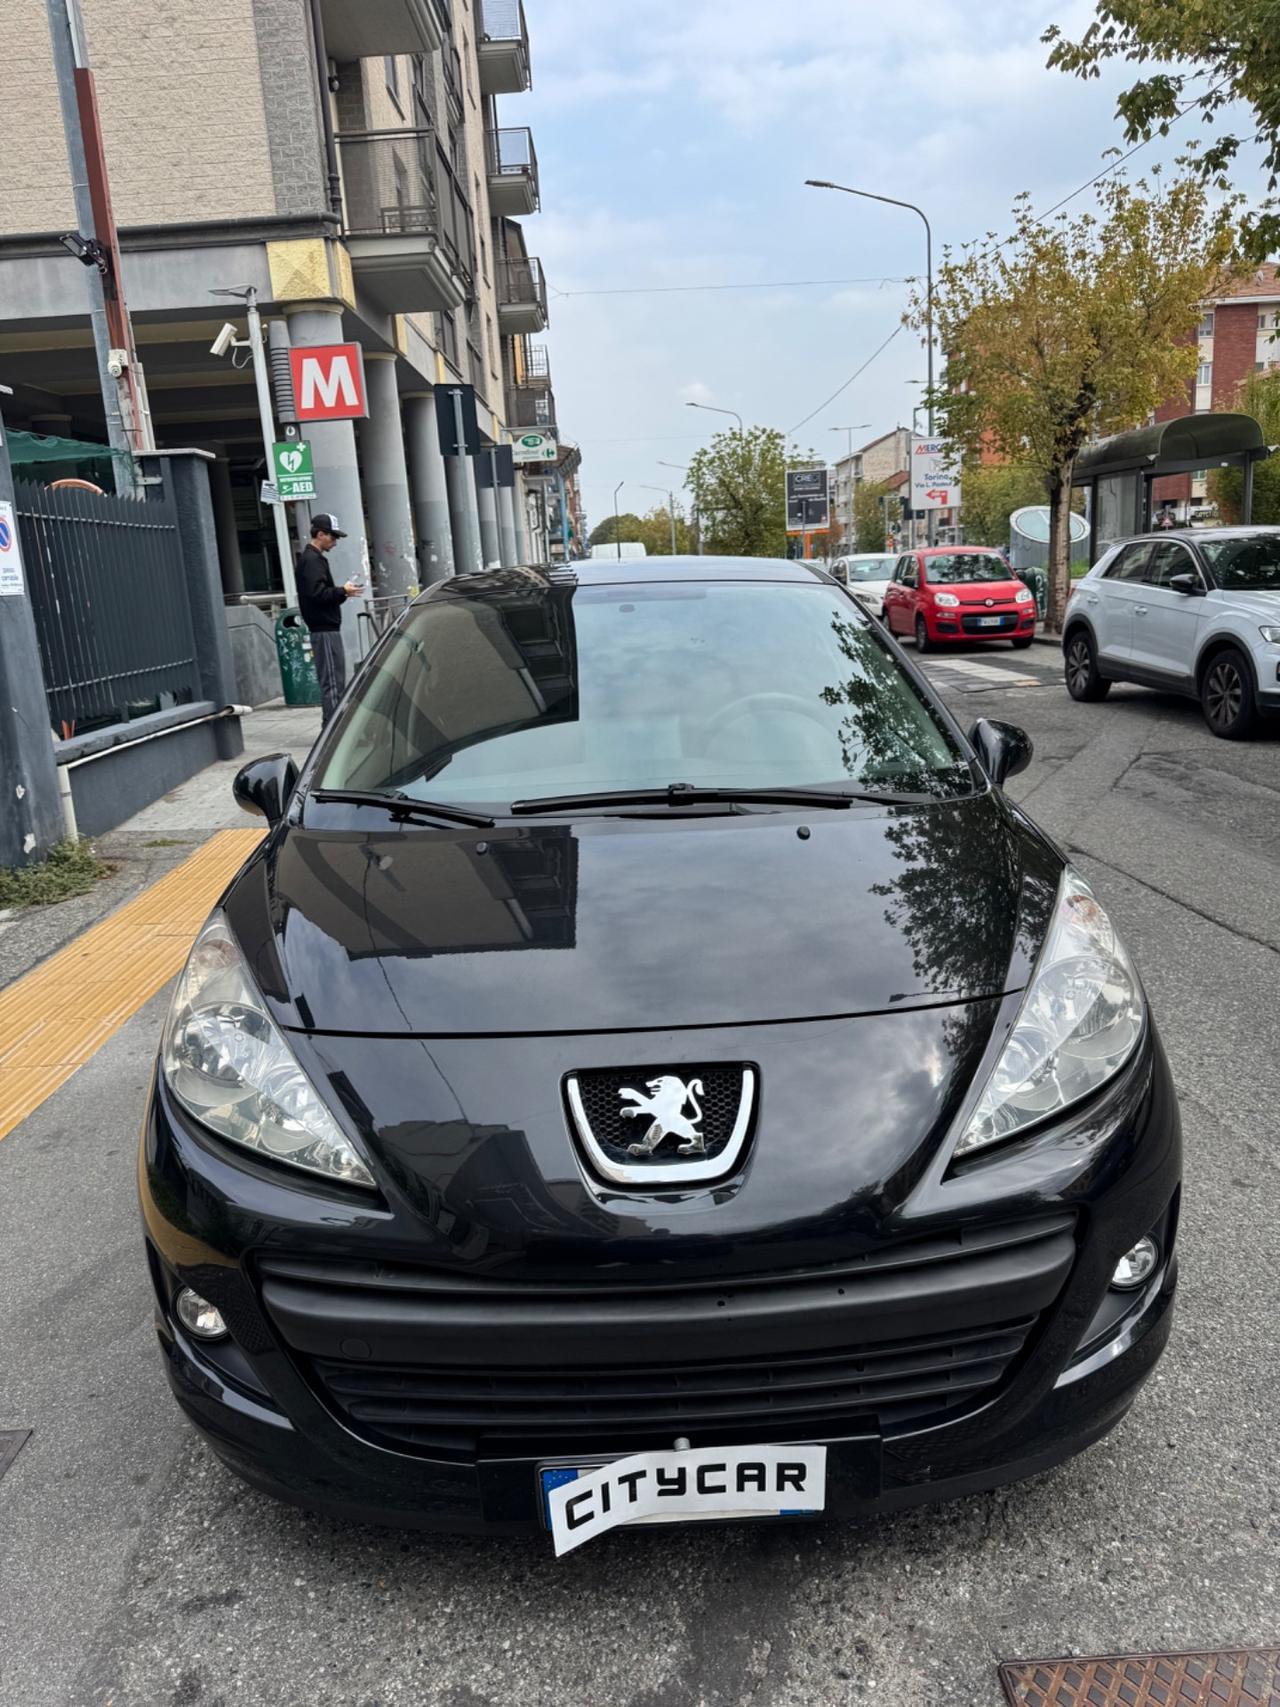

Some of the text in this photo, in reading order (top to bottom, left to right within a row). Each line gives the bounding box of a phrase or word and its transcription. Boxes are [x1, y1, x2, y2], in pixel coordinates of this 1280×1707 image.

[301, 355, 359, 409] M
[292, 481, 314, 493] AED
[565, 1462, 807, 1531] CITYCAR
